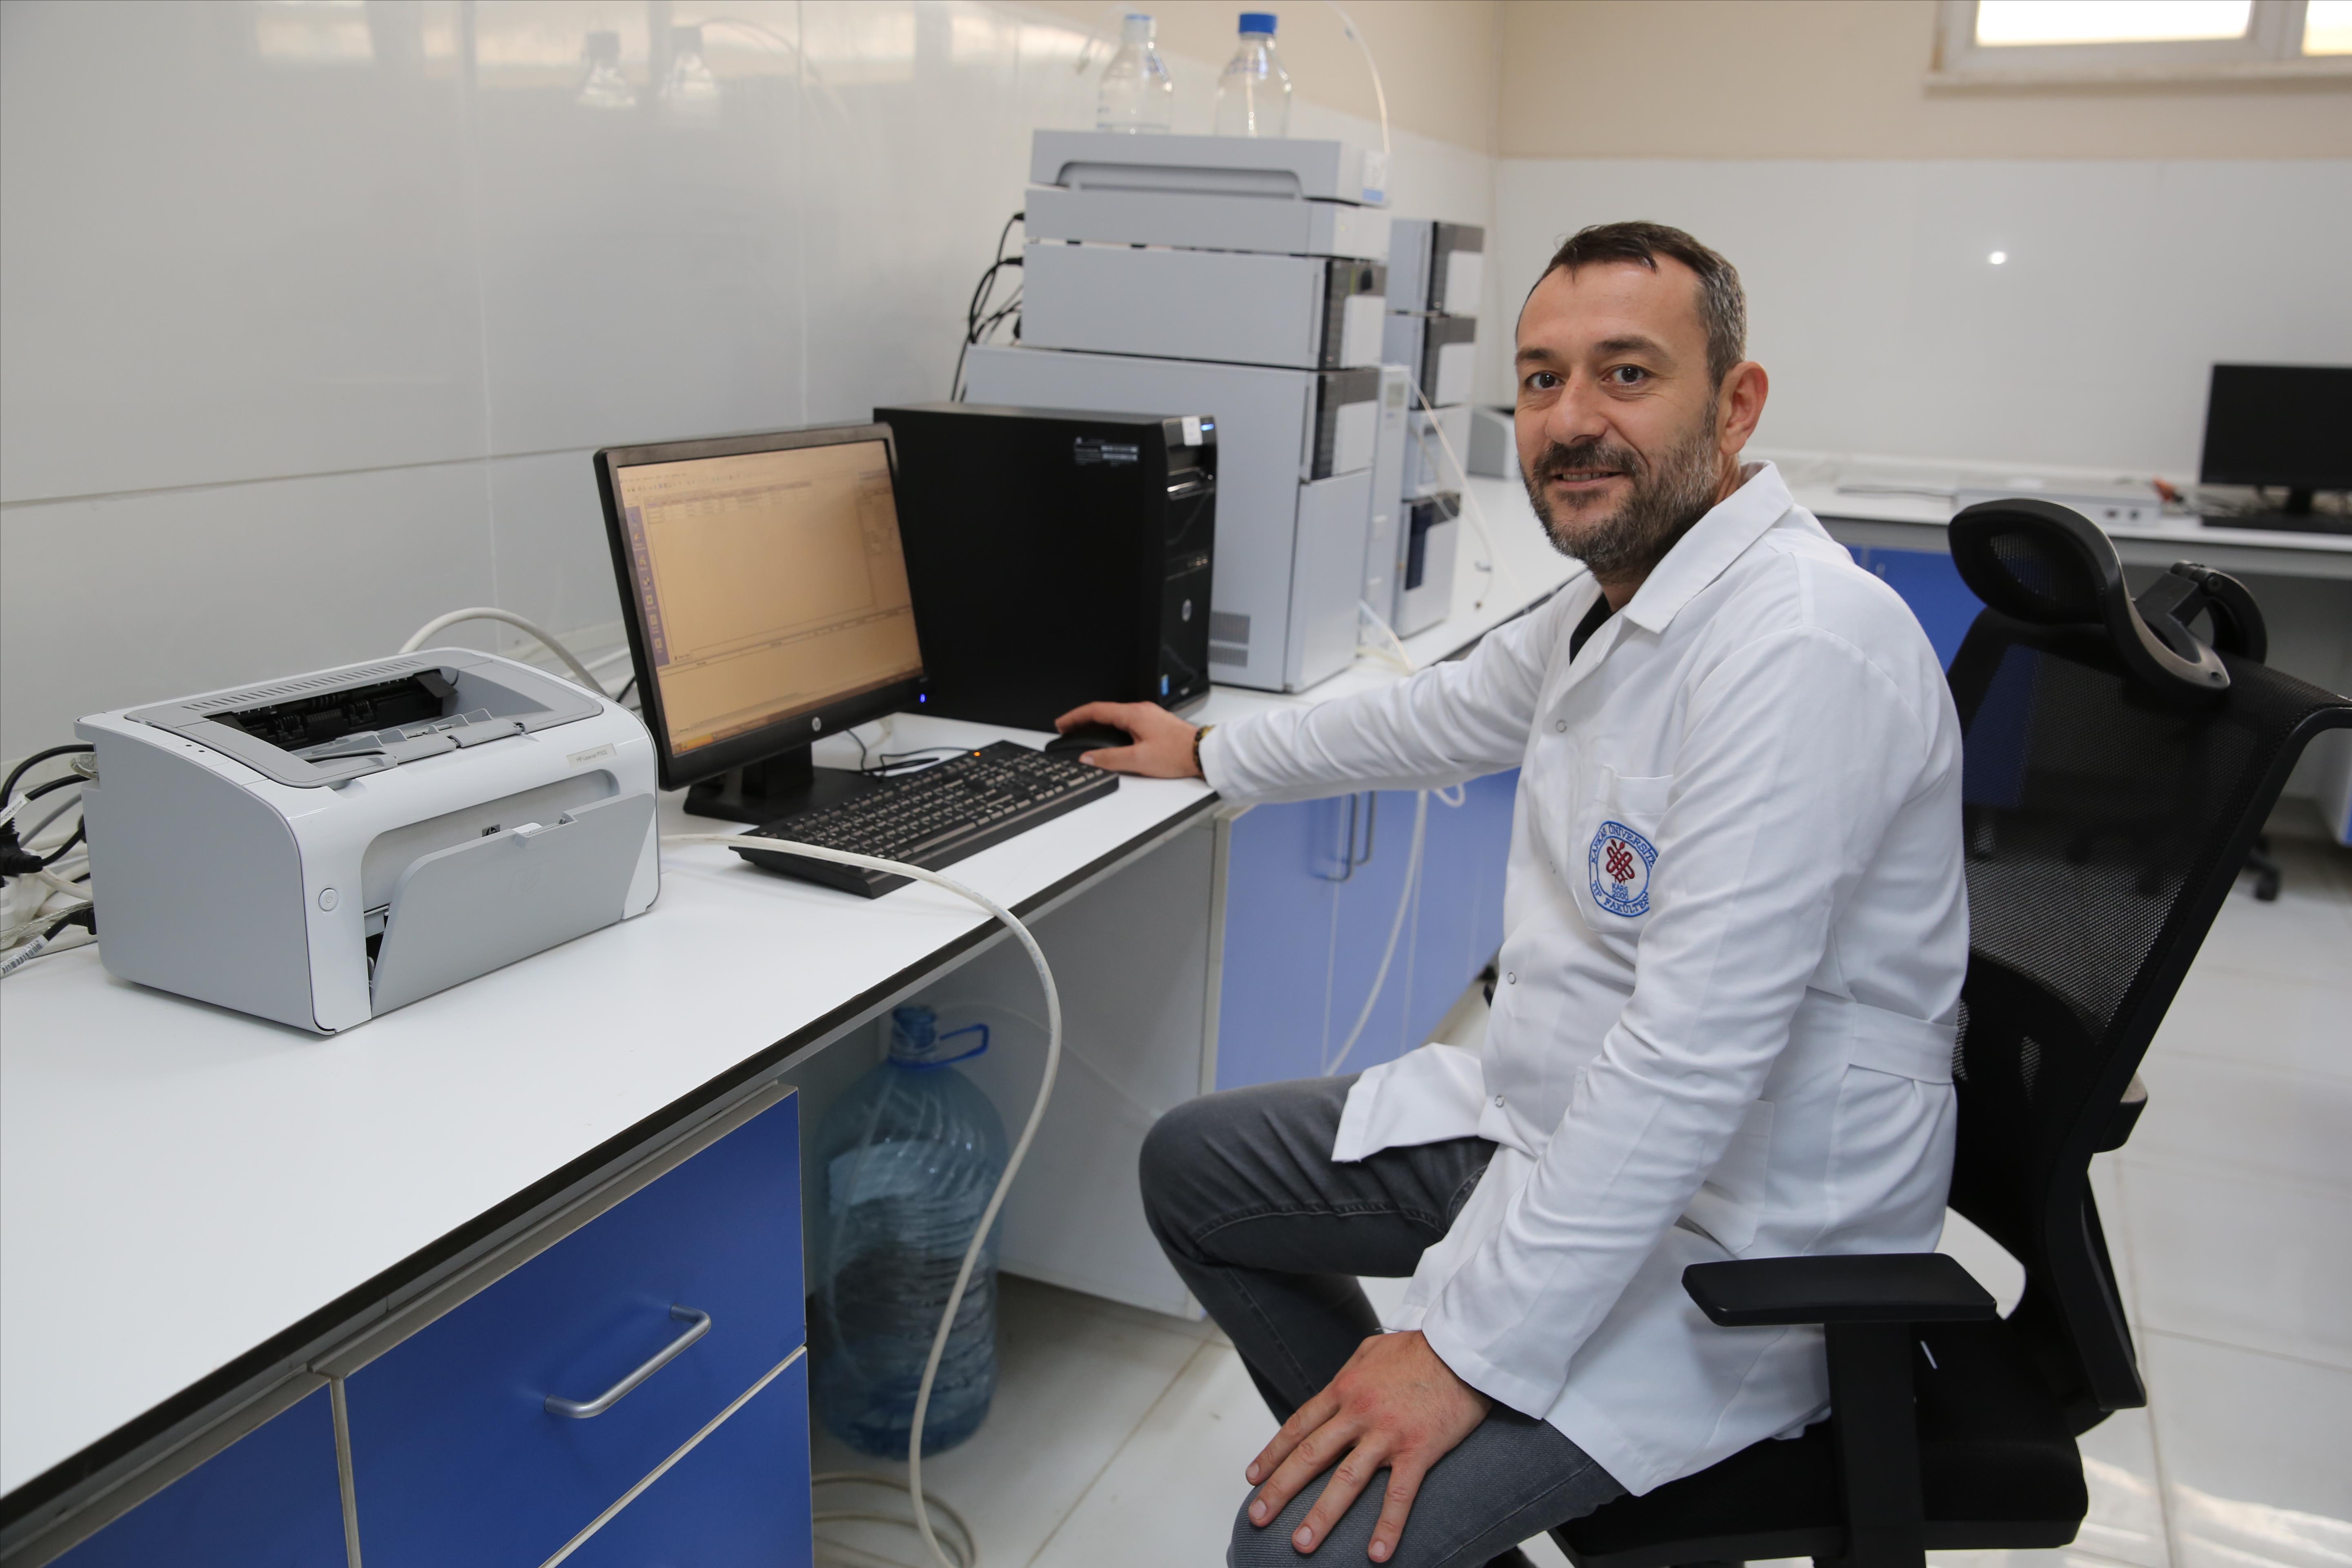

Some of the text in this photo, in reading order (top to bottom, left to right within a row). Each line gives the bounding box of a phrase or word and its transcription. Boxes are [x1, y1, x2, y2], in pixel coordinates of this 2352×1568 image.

[1591, 827, 1607, 864] KAFKAS
[1612, 882, 1628, 894] KARS
[1613, 890, 1628, 901] 2000
